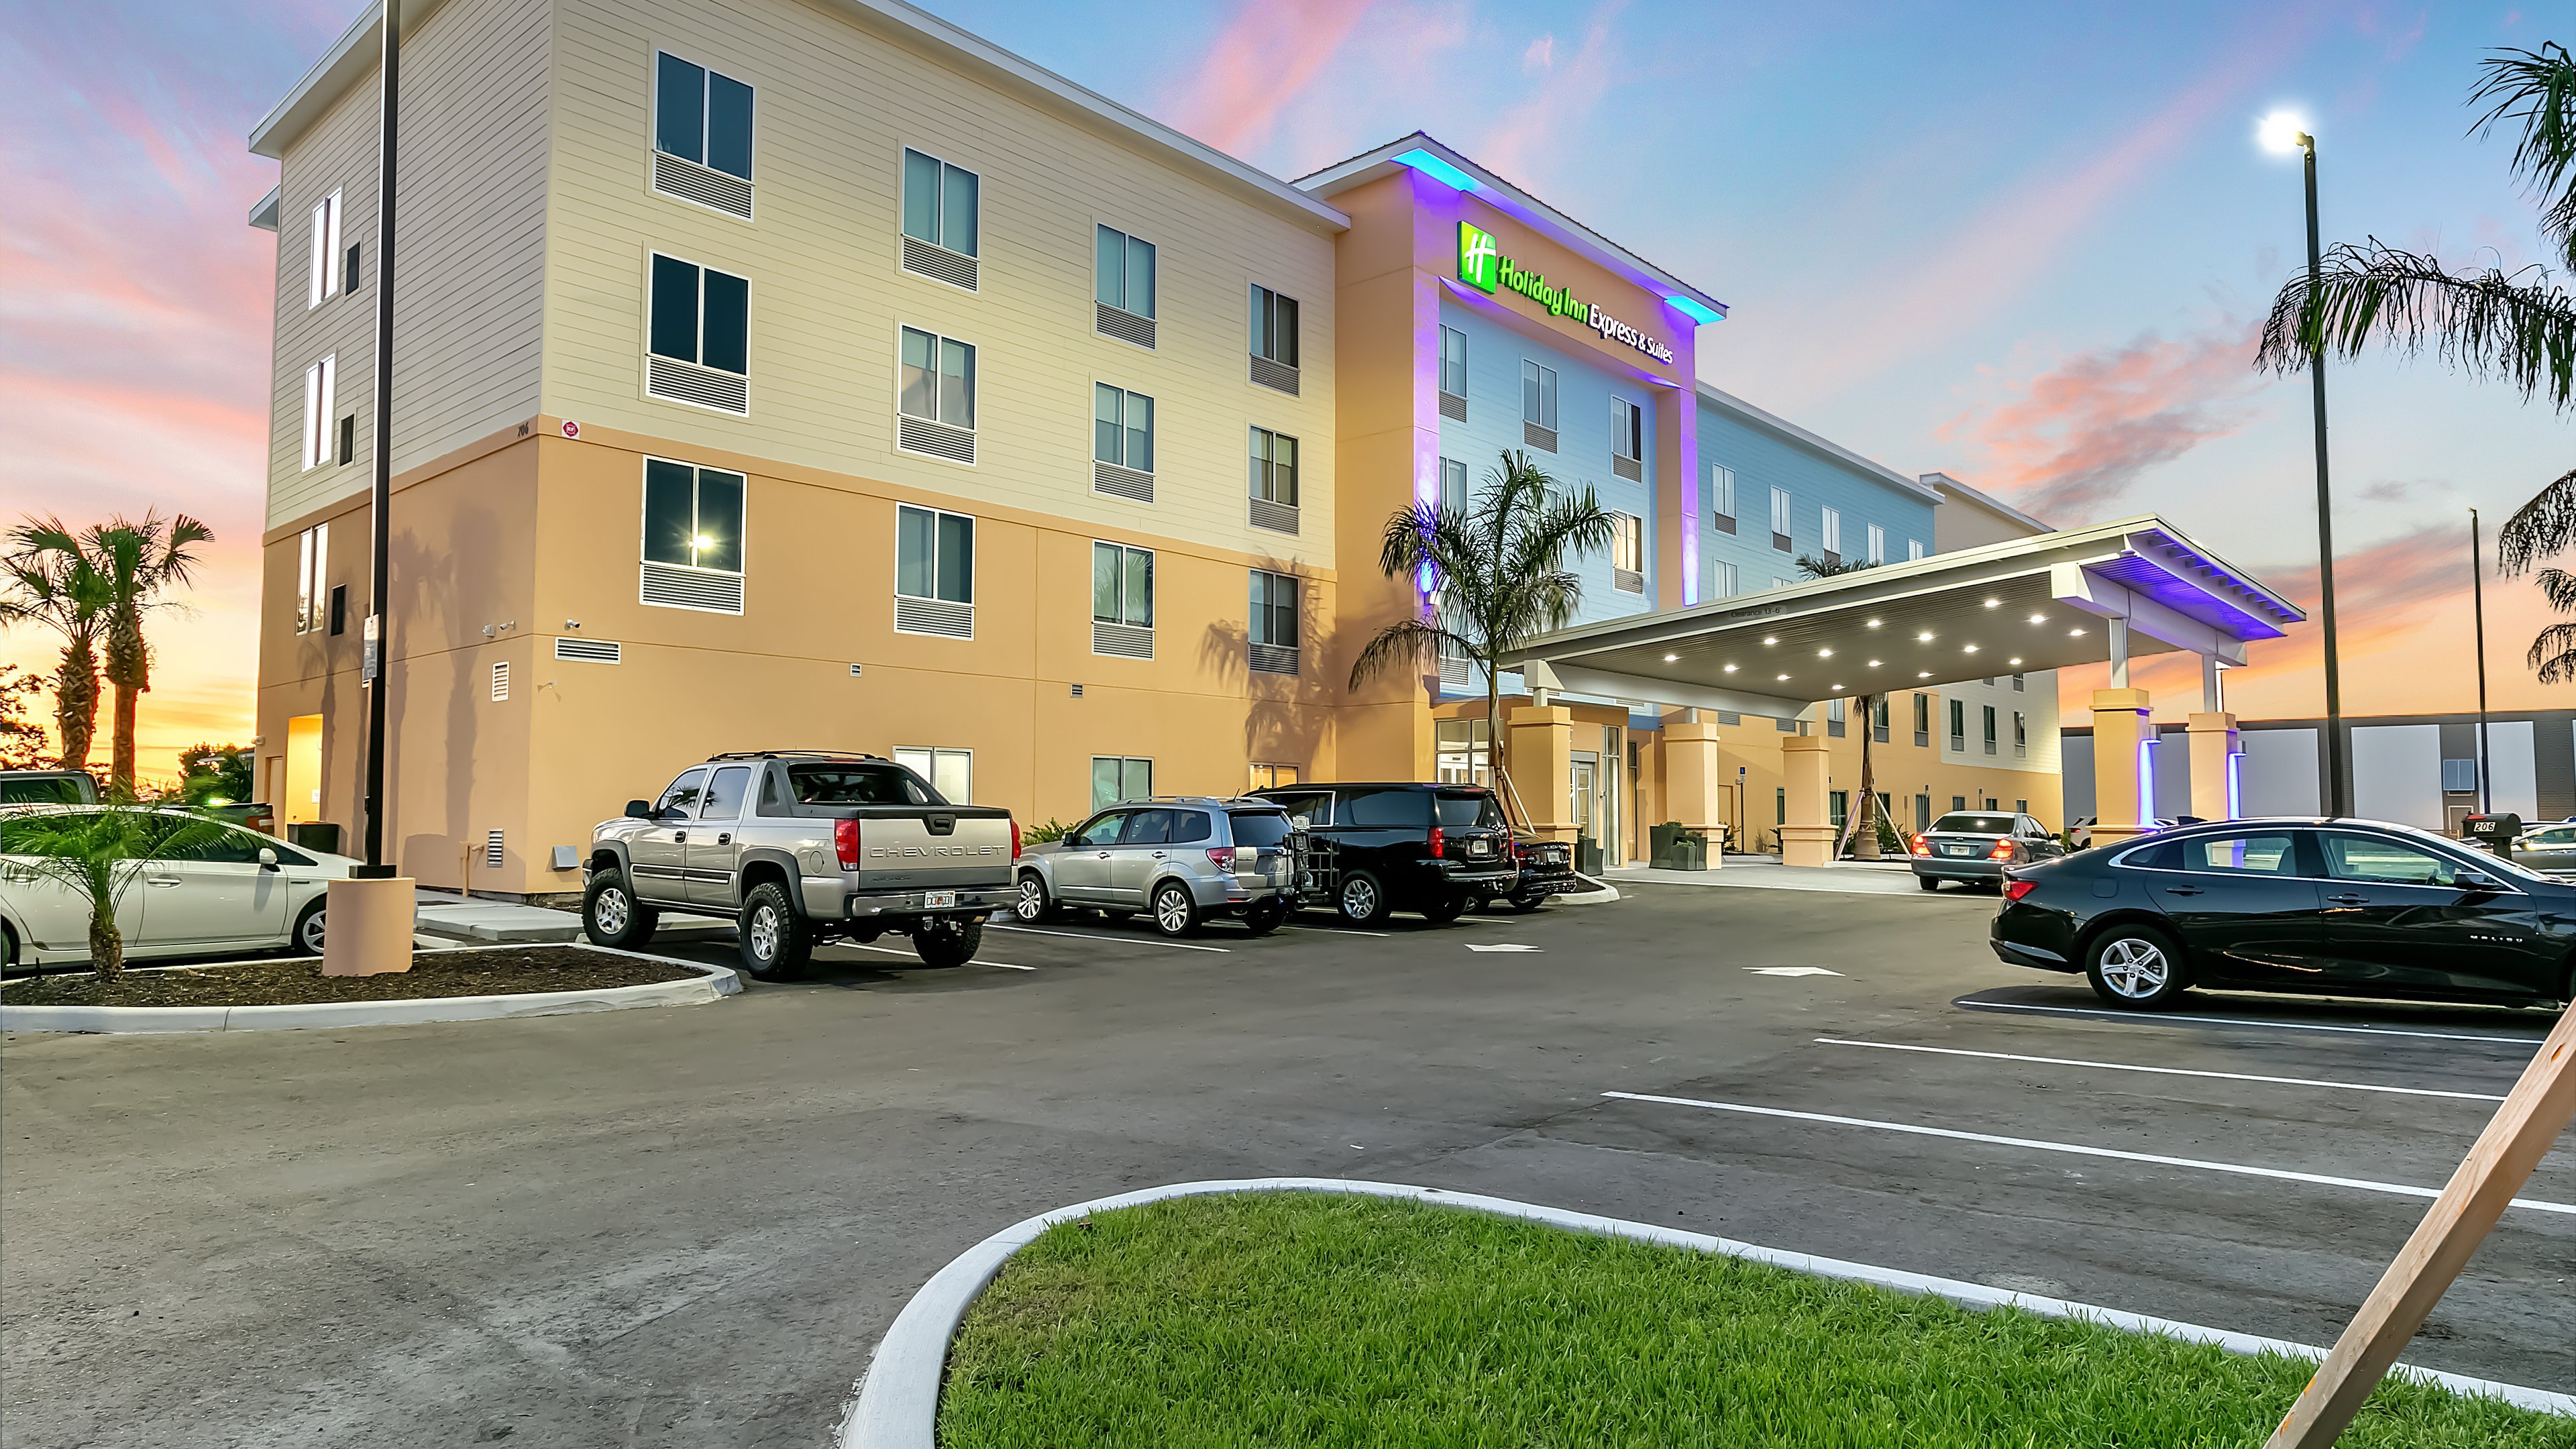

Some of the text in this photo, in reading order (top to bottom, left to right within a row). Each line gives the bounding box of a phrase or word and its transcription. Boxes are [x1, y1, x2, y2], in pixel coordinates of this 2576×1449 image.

[1499, 255, 1674, 364] Holiday Inn Express & Suites
[1731, 610, 1762, 618] Clearance
[2475, 822, 2494, 831] 206
[869, 845, 1006, 858] CHEVROLET
